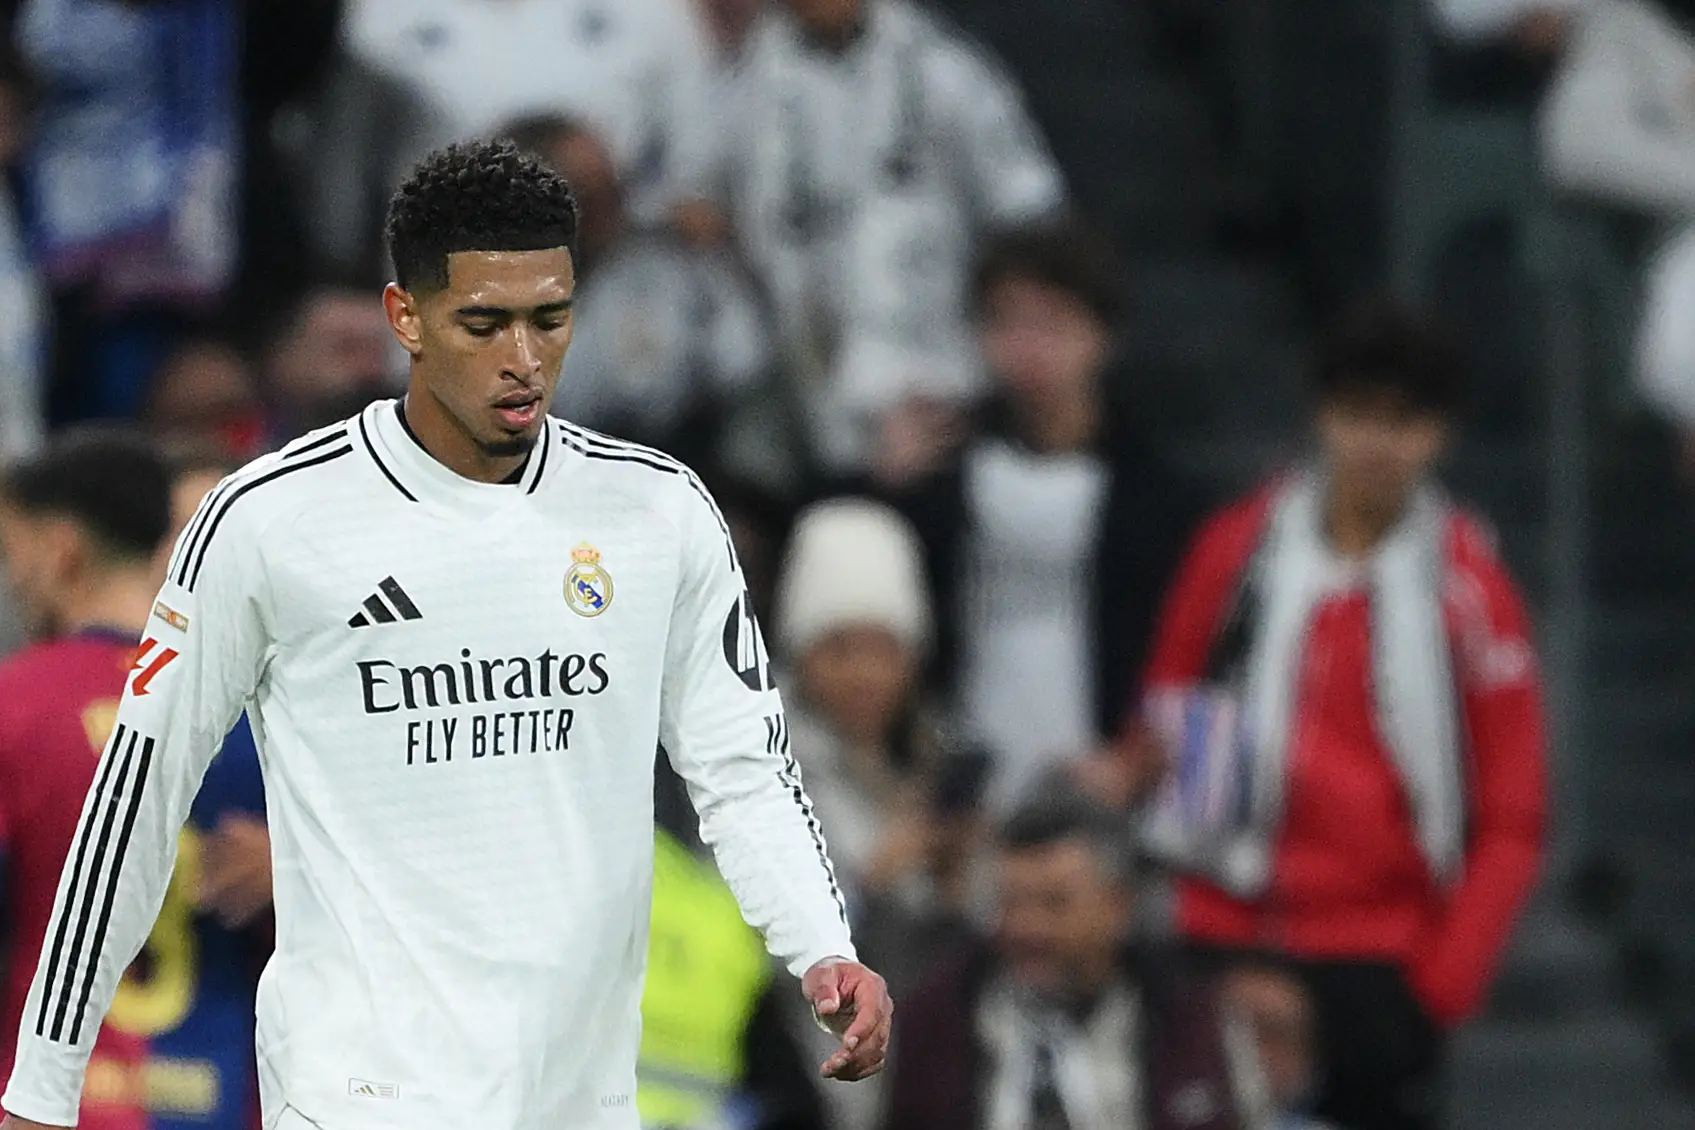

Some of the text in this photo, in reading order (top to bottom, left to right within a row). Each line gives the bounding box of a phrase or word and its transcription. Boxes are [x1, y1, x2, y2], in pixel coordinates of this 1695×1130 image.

[356, 648, 609, 714] Emirates
[407, 709, 574, 765] FLY BETTER
